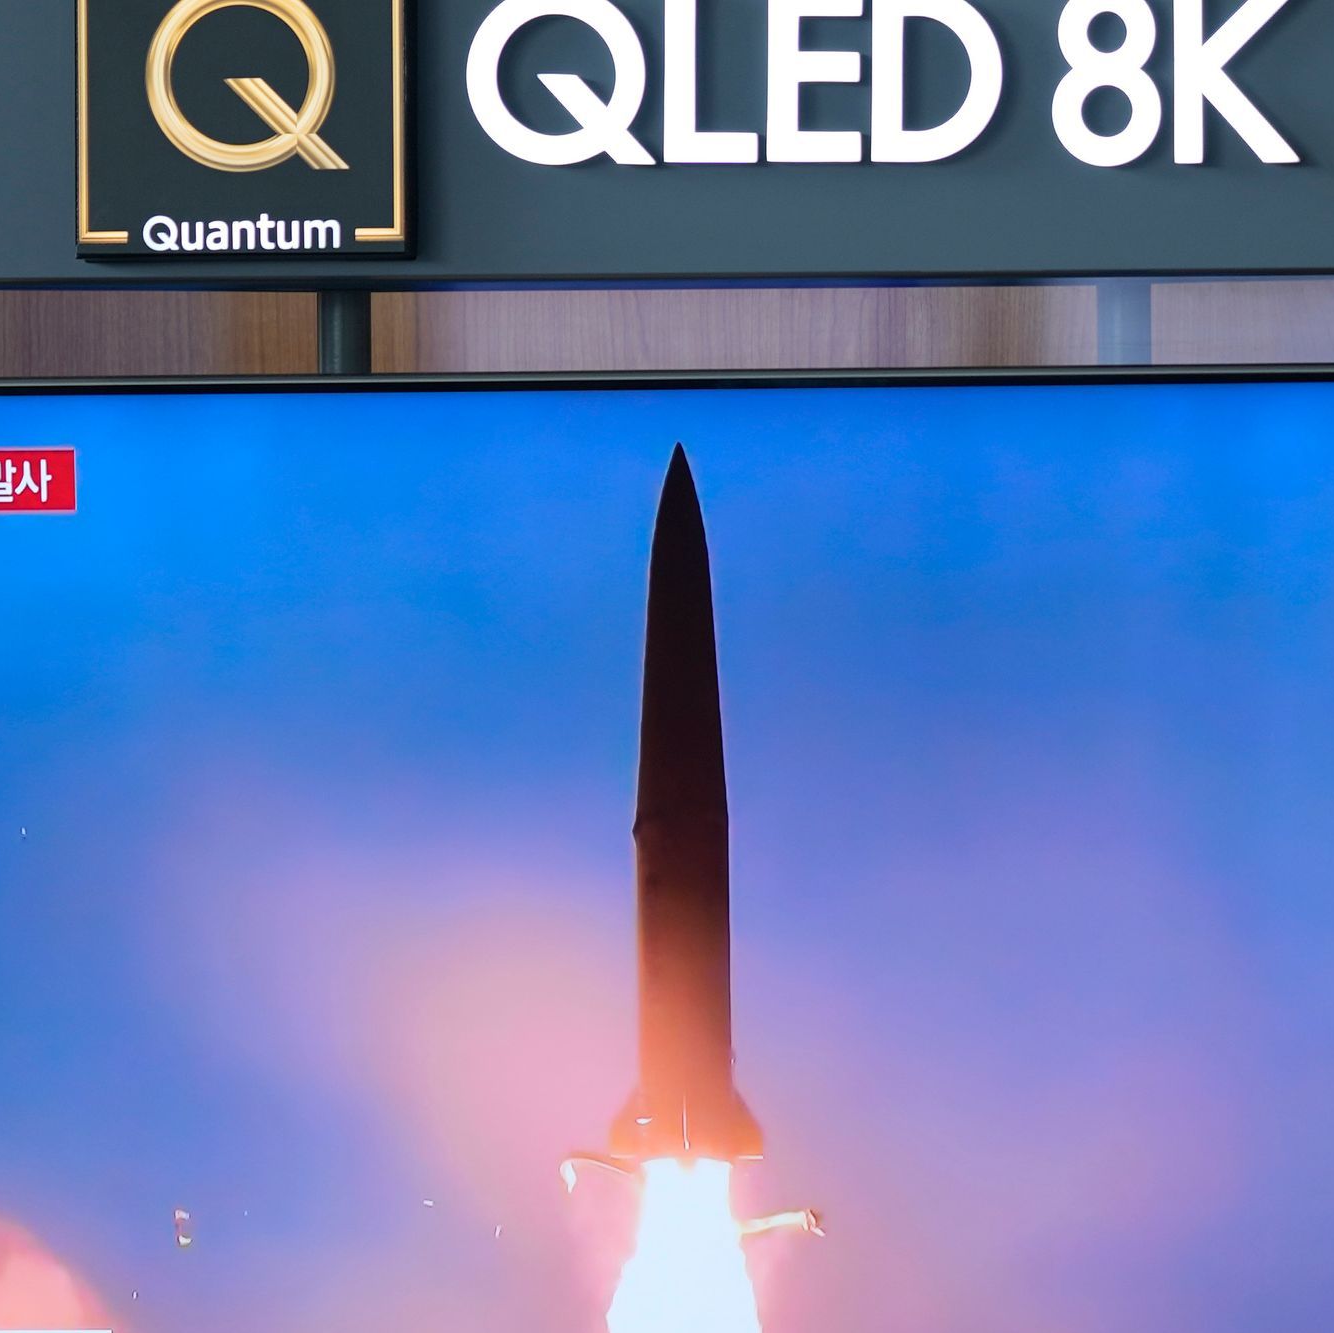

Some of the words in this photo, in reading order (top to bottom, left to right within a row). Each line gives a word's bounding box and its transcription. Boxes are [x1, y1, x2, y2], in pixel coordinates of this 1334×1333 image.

[145, 0, 349, 172] Q
[466, 0, 1004, 166] QLED
[1051, 0, 1300, 167] 8K
[142, 213, 342, 251] Quantum
